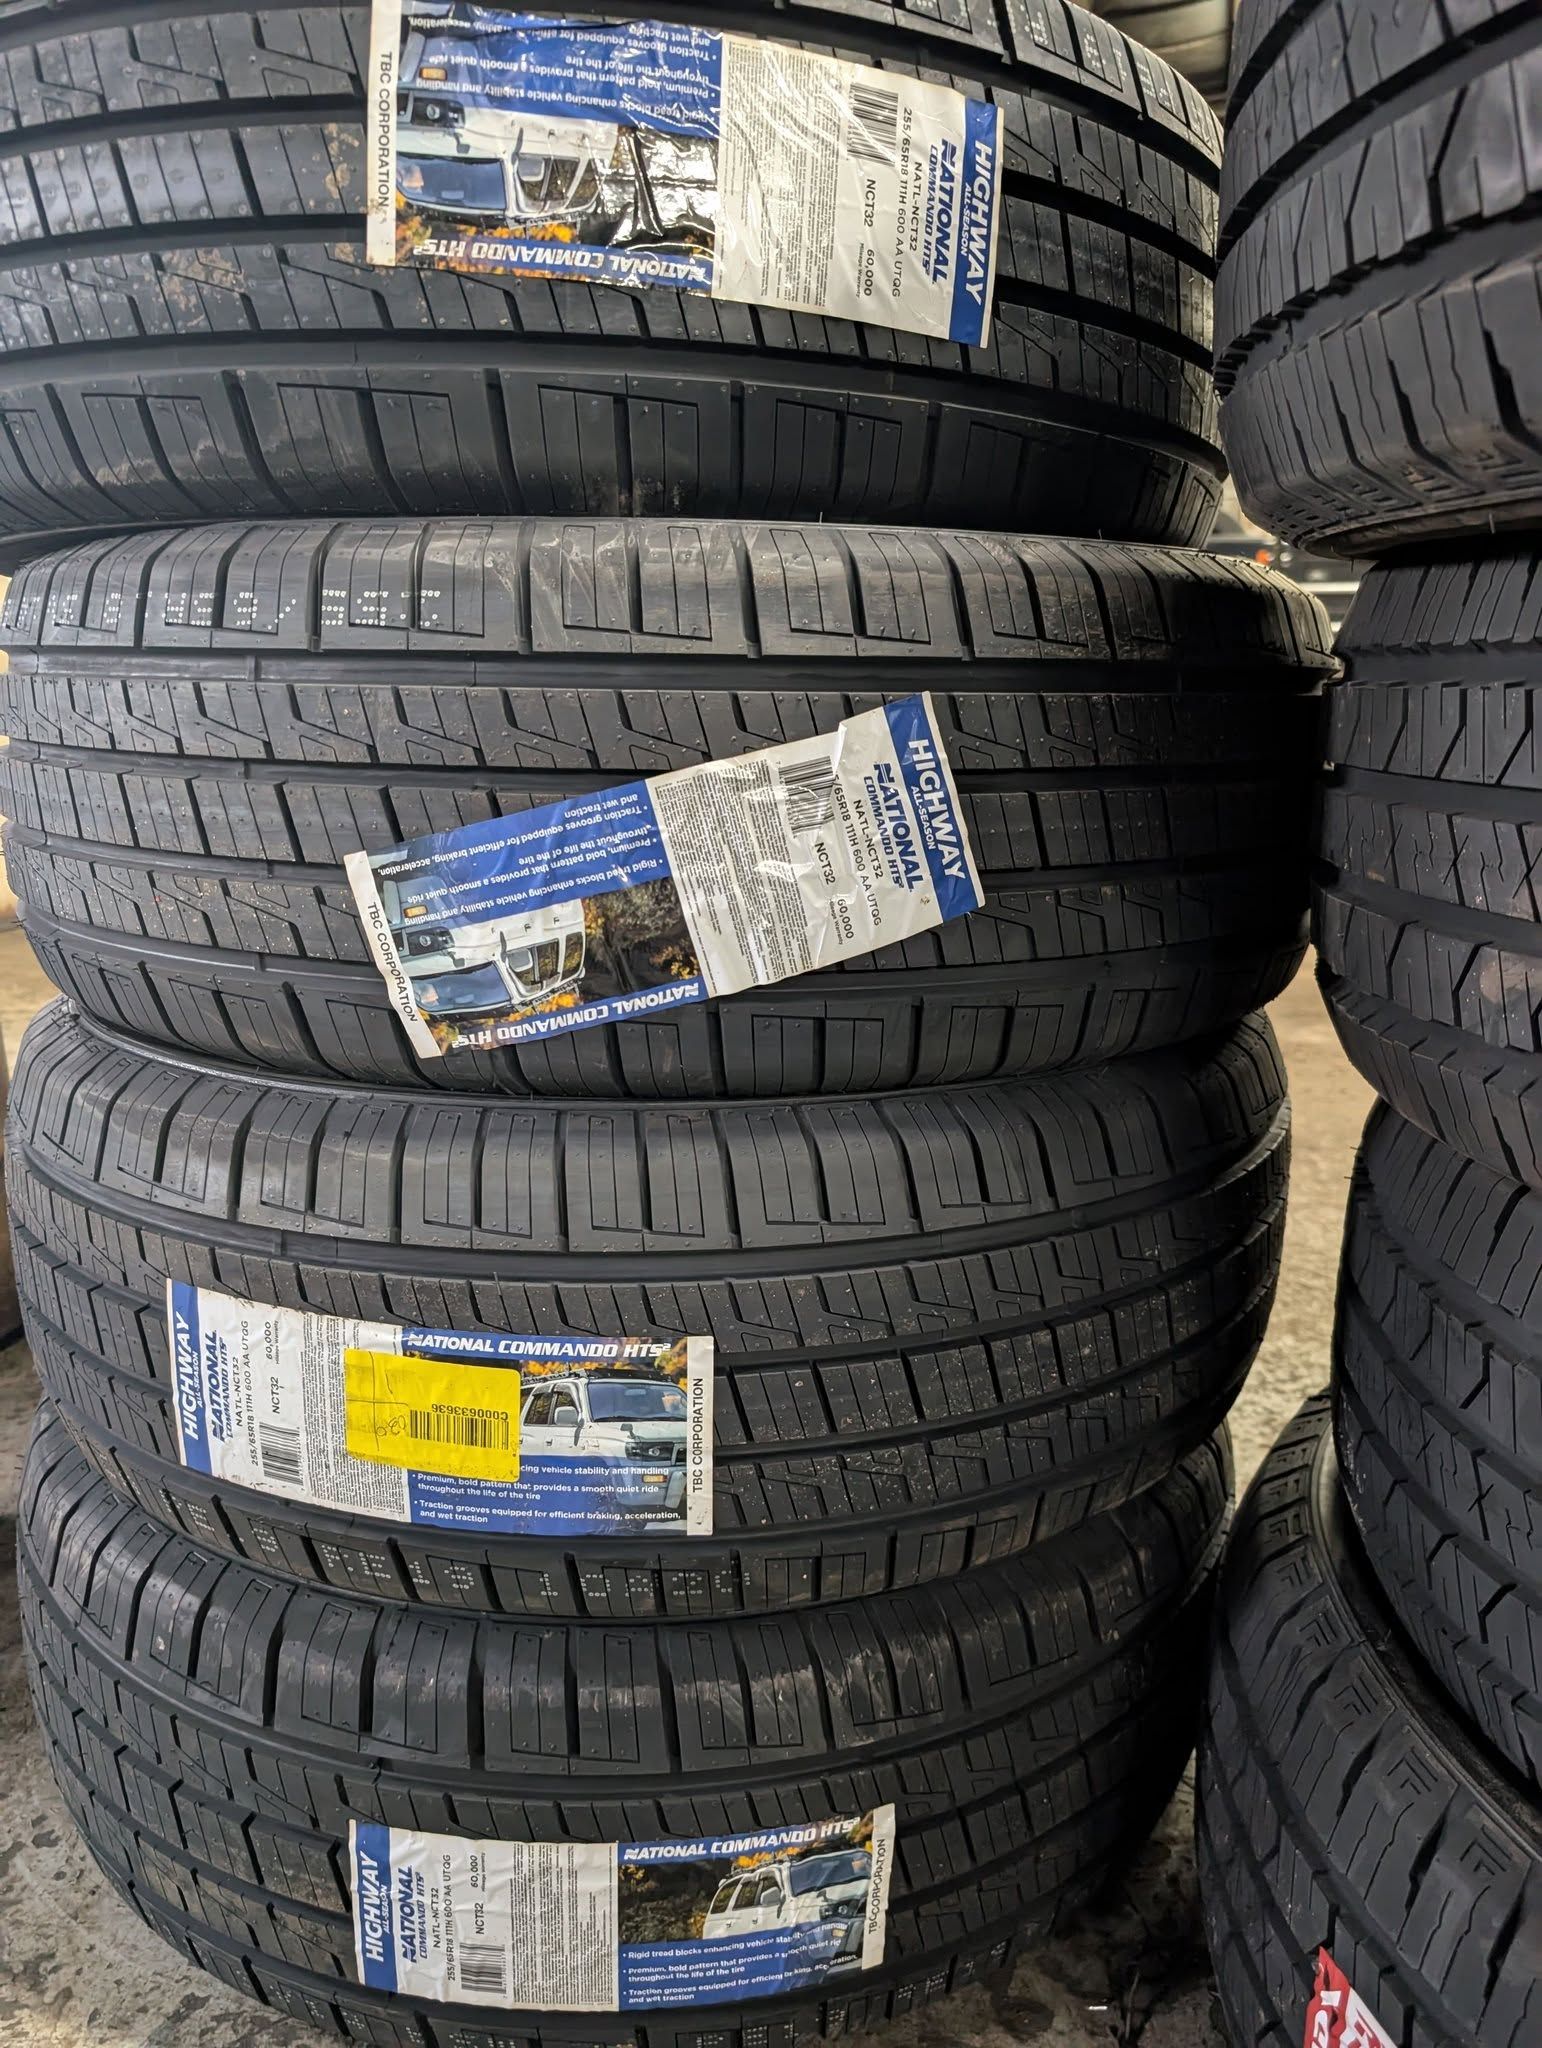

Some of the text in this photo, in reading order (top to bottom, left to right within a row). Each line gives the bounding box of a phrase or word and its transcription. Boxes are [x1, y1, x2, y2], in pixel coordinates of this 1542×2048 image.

[376, 51, 392, 207] TBC CORPORATION
[891, 107, 912, 297] 255/65R18 111H 600 AA UTQG
[909, 161, 921, 251] NATL-NCT32
[924, 144, 937, 236] COMMANDO
[932, 138, 956, 283] NATIONAL
[960, 182, 971, 256] ALL-SEASON
[965, 140, 992, 305] HIGHWAY
[471, 242, 604, 268] COMMANDO
[863, 178, 875, 296] NCT32 60,000
[609, 255, 705, 281] NATIONAL
[564, 793, 637, 818] and wet traction
[863, 775, 894, 855] COMMANDO
[907, 738, 965, 878] HIGHWAY
[910, 785, 936, 849] ALL-SEASON
[377, 805, 641, 875] Traction grooves equipped for efficient braking, acceleration,
[606, 837, 650, 853] Premium,
[853, 799, 883, 878] NATL-NCT32
[873, 762, 923, 892] NATIONAL
[518, 826, 647, 865] throughout the life of the tire
[550, 853, 584, 868] pattern
[585, 849, 606, 861] bold
[490, 867, 529, 883] provides
[531, 863, 549, 874] that
[575, 872, 605, 884] blocks
[631, 859, 657, 872] Rigid
[845, 823, 858, 846] 111H
[852, 848, 865, 871] 600
[860, 875, 871, 891] AA
[866, 893, 881, 926] UTQG
[407, 893, 423, 903] ride
[424, 887, 447, 899] quiet
[448, 880, 481, 894] smooth
[496, 891, 527, 904] vehicle
[528, 879, 574, 897] enhancing
[814, 842, 854, 938] NCT32 60,000
[403, 911, 441, 925] handling
[441, 907, 458, 918] and
[460, 899, 494, 913] stability
[367, 901, 417, 1021] TBC CORPORATION
[611, 982, 698, 1014] NATIONAL
[496, 1005, 608, 1039] COMMANDO
[240, 1320, 248, 1350] UTQG
[407, 1333, 493, 1352] NATIONAL
[497, 1340, 618, 1357] COMMANDO
[175, 1310, 198, 1440] HIGHWAY
[192, 1350, 202, 1407] ALL-SEASON
[242, 1353, 250, 1368] AA
[264, 1321, 280, 1414] NCT32 60,000
[204, 1330, 224, 1442] NATIONAL
[221, 1367, 233, 1438] COMMANDO
[232, 1356, 242, 1426] NATL-NCT32
[245, 1393, 253, 1412] 111H
[431, 1403, 509, 1421] C000633636
[247, 1415, 258, 1465] 255/65R18
[692, 1378, 703, 1492] TBC CORPORATION
[417, 1473, 456, 1484] Premium,
[480, 1481, 511, 1489] pattern
[616, 1485, 639, 1494] quiet
[418, 1483, 464, 1494] throughout
[574, 1466, 610, 1475] stability
[612, 1466, 628, 1474] and
[630, 1466, 668, 1475] handling
[419, 1500, 453, 1509] Traction
[456, 1505, 489, 1513] grooves
[491, 1508, 532, 1517] equipped
[549, 1510, 584, 1518] efficient
[587, 1511, 622, 1520] braking,
[624, 1511, 680, 1521] acceleration,
[454, 1513, 487, 1522] traction
[623, 1841, 706, 1865] NATIONAL
[710, 1827, 816, 1853] COMMANDO
[442, 1854, 451, 1881] UTQG
[444, 1884, 451, 1896] AA
[469, 1854, 484, 1934] NCT32 60,000
[869, 1838, 885, 1934] TBC CORPORATION
[359, 1850, 383, 1961] HIGHWAY
[379, 1884, 389, 1933] ALL-SEASON
[397, 1866, 416, 1963] NATIONAL
[430, 1887, 440, 1948] NATL-NCT32
[444, 1898, 452, 1917] 600
[416, 1899, 427, 1958] COMMANDO
[445, 1937, 455, 1980] 255/65R18
[628, 1969, 673, 1983] throughout
[705, 1968, 714, 1976] of
[662, 1992, 694, 2002] traction
